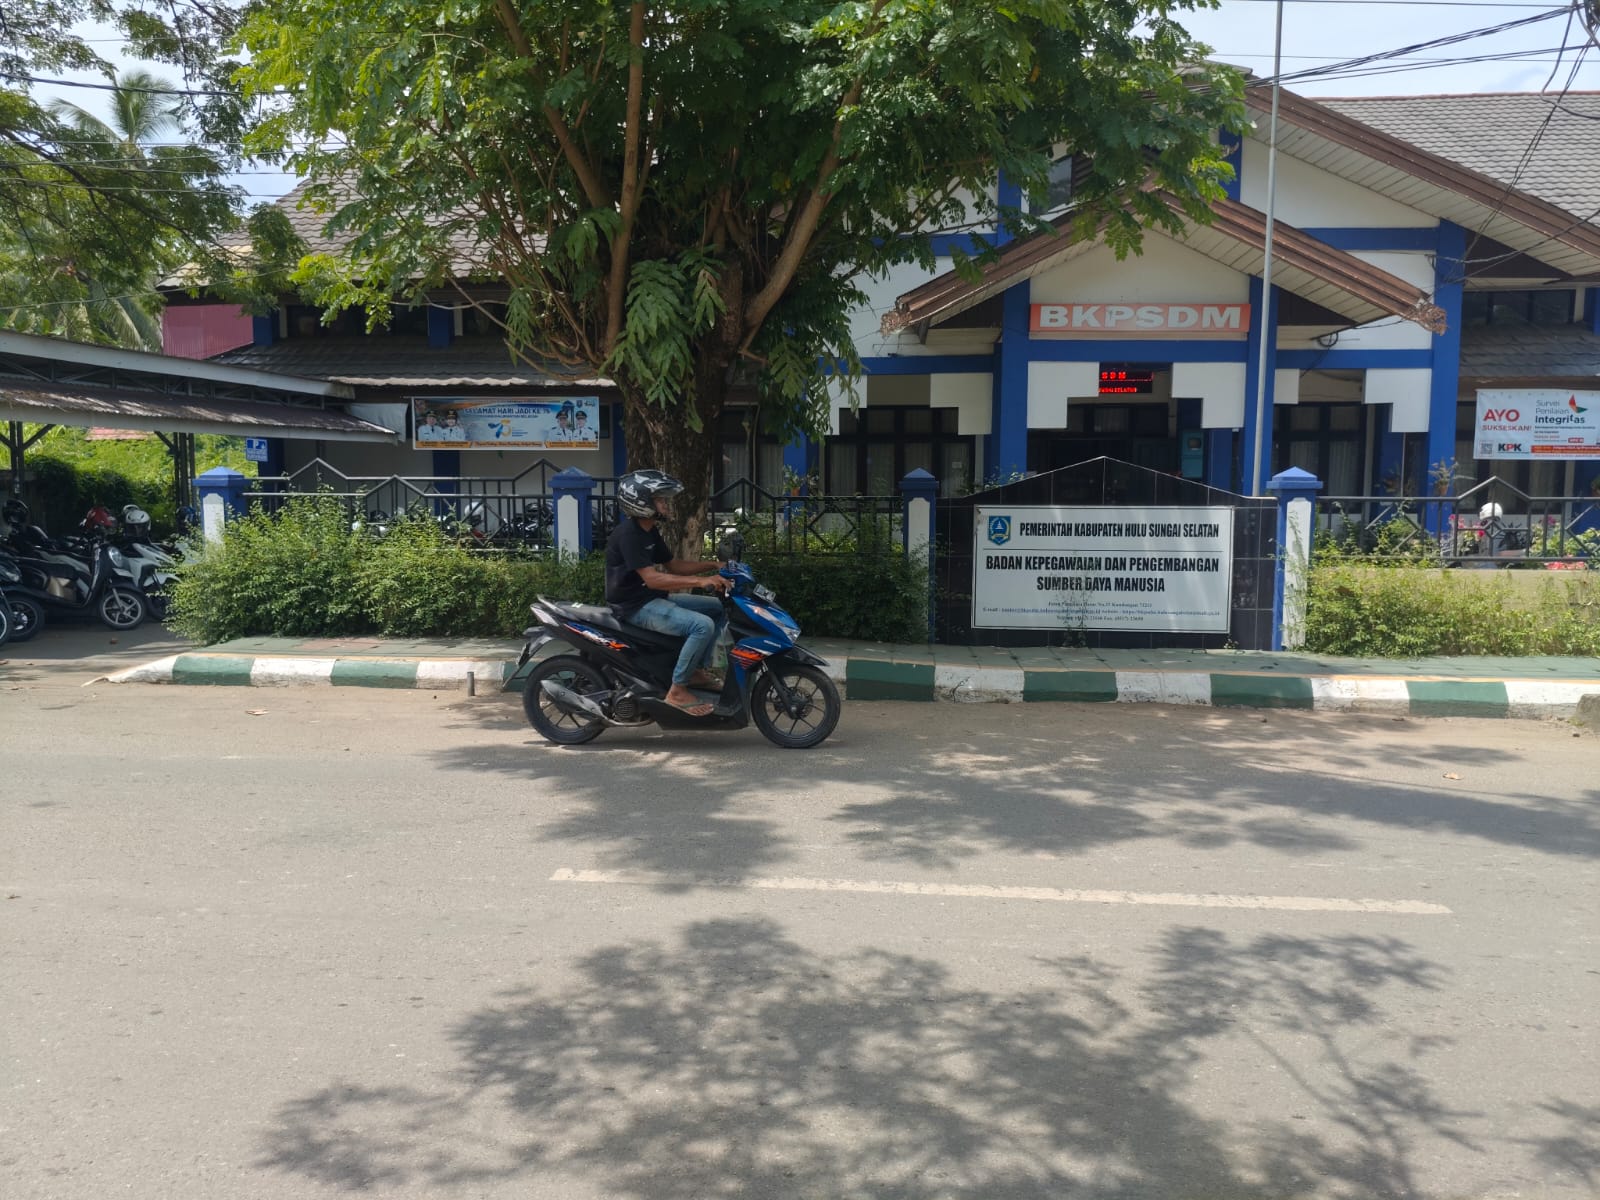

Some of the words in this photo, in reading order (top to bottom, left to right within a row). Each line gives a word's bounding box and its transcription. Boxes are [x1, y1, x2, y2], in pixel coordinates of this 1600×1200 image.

[1039, 305, 1241, 329] BKPSDM
[1483, 409, 1520, 422] AYO
[1536, 407, 1569, 415] Penilaian
[1535, 414, 1585, 425] Integritas
[1498, 443, 1522, 452] KPK
[1020, 523, 1072, 537] PEMERINTAH
[1074, 523, 1123, 537] KABUPATEN
[1125, 524, 1147, 537] HULU
[1149, 524, 1181, 538] SUNGAI
[1183, 524, 1219, 538] SELATAN
[986, 555, 1023, 570] BADAN
[1025, 556, 1102, 571] KEPEGAWAIAN
[1105, 557, 1127, 571] DAN
[1129, 557, 1219, 573] PENGEMBANGAN
[1036, 576, 1082, 591] SUMBER
[1085, 577, 1112, 592] DAYA
[1114, 577, 1165, 592] MANUSIA
